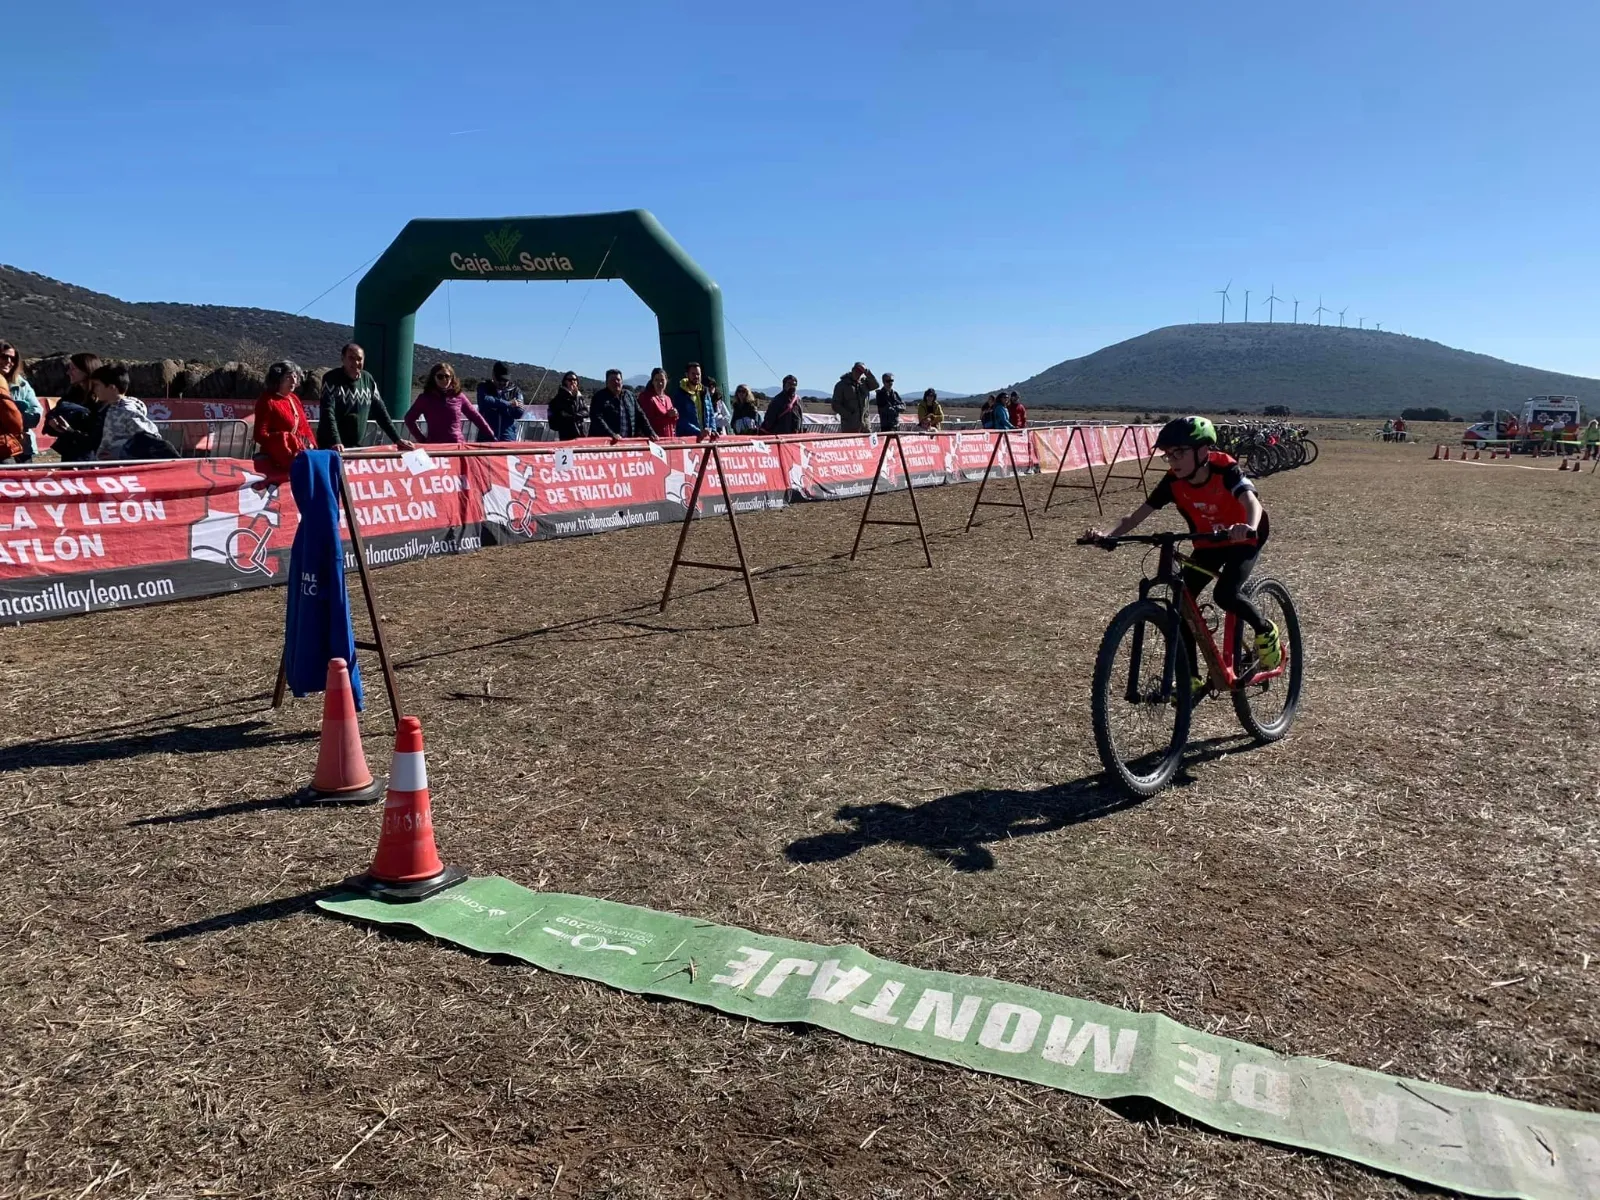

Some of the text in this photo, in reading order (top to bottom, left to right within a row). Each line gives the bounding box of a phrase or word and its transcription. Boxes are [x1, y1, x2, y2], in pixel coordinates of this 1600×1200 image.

[450, 252, 493, 274] Caja
[520, 252, 574, 271] Soria
[540, 458, 655, 484] CASTILLA Y LEÓN
[561, 454, 568, 465] 2
[97, 475, 146, 493] DE
[399, 478, 412, 496] Y
[419, 470, 470, 495] LEÓN
[545, 479, 632, 504] DE TRIATLÓN
[43, 503, 67, 528] Y
[79, 494, 166, 526] LEÓN
[710, 945, 1138, 1074] MONTAJE
[1173, 1043, 1291, 1117] DE
